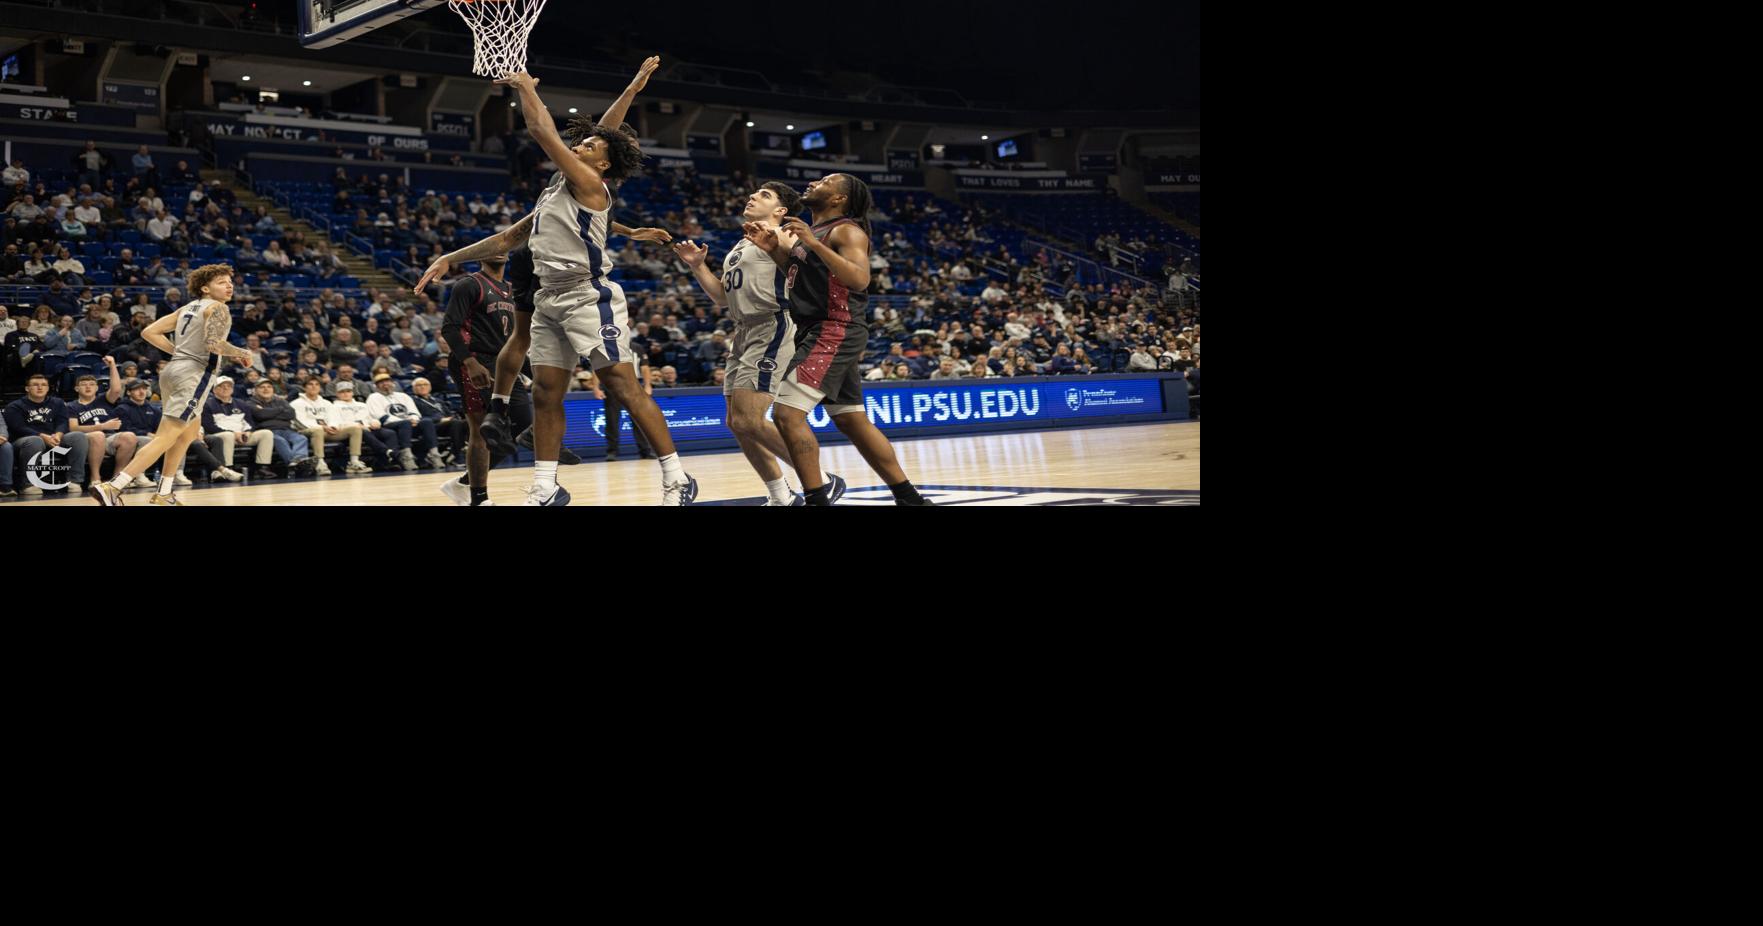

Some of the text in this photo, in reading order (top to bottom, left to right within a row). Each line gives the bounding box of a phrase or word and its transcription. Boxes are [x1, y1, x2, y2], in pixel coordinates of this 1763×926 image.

[20, 108, 77, 121] STAE
[207, 123, 235, 136] MAY
[368, 135, 428, 150] OF OURS
[962, 177, 1020, 188] THAT LOVES
[1038, 179, 1095, 188] THY NAME
[1161, 175, 1181, 183] MAY
[725, 268, 743, 292] 30
[181, 314, 193, 335] 7
[91, 407, 109, 417] STATE
